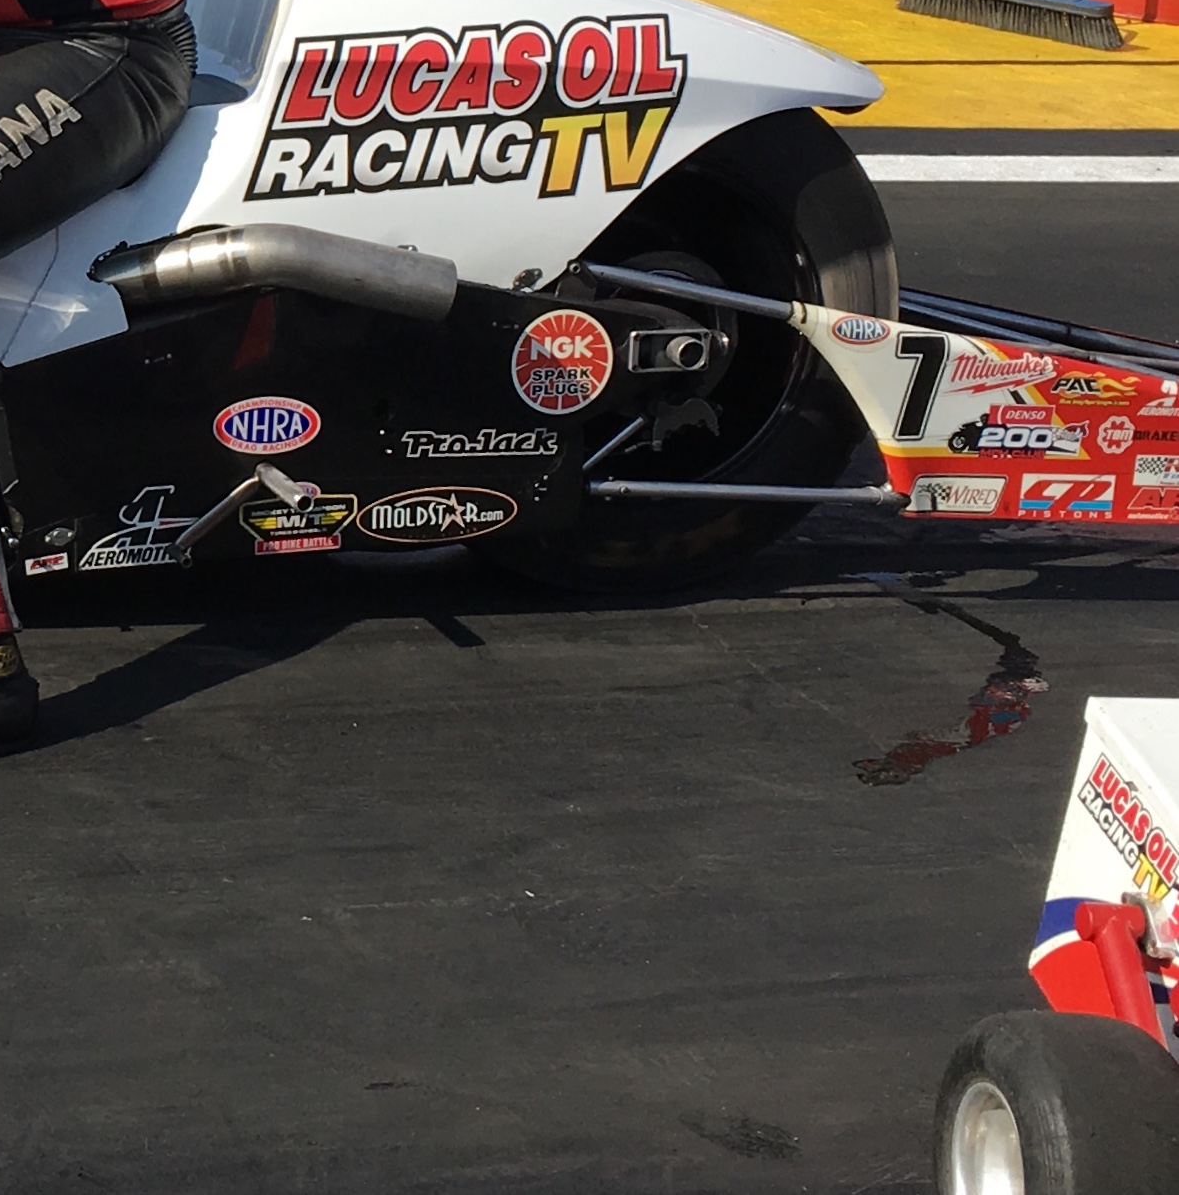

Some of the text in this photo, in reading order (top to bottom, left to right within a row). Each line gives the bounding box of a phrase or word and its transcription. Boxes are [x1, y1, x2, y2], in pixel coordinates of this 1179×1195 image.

[277, 21, 680, 127] LUCAS OIL
[251, 106, 672, 194] RACING TV
[840, 317, 883, 339] NHRA
[531, 335, 594, 360] NGK
[532, 368, 592, 381] SPARK
[950, 353, 1054, 383] Milwaukee
[531, 383, 591, 396] PLUGS
[895, 332, 950, 441] 7
[232, 408, 303, 442] NHRA
[1005, 410, 1047, 421] DENSO
[978, 426, 1053, 448] 200
[1018, 510, 1113, 520] PISTONS
[1078, 785, 1139, 868] RACING
[1089, 757, 1178, 886] LUCAS OIL
